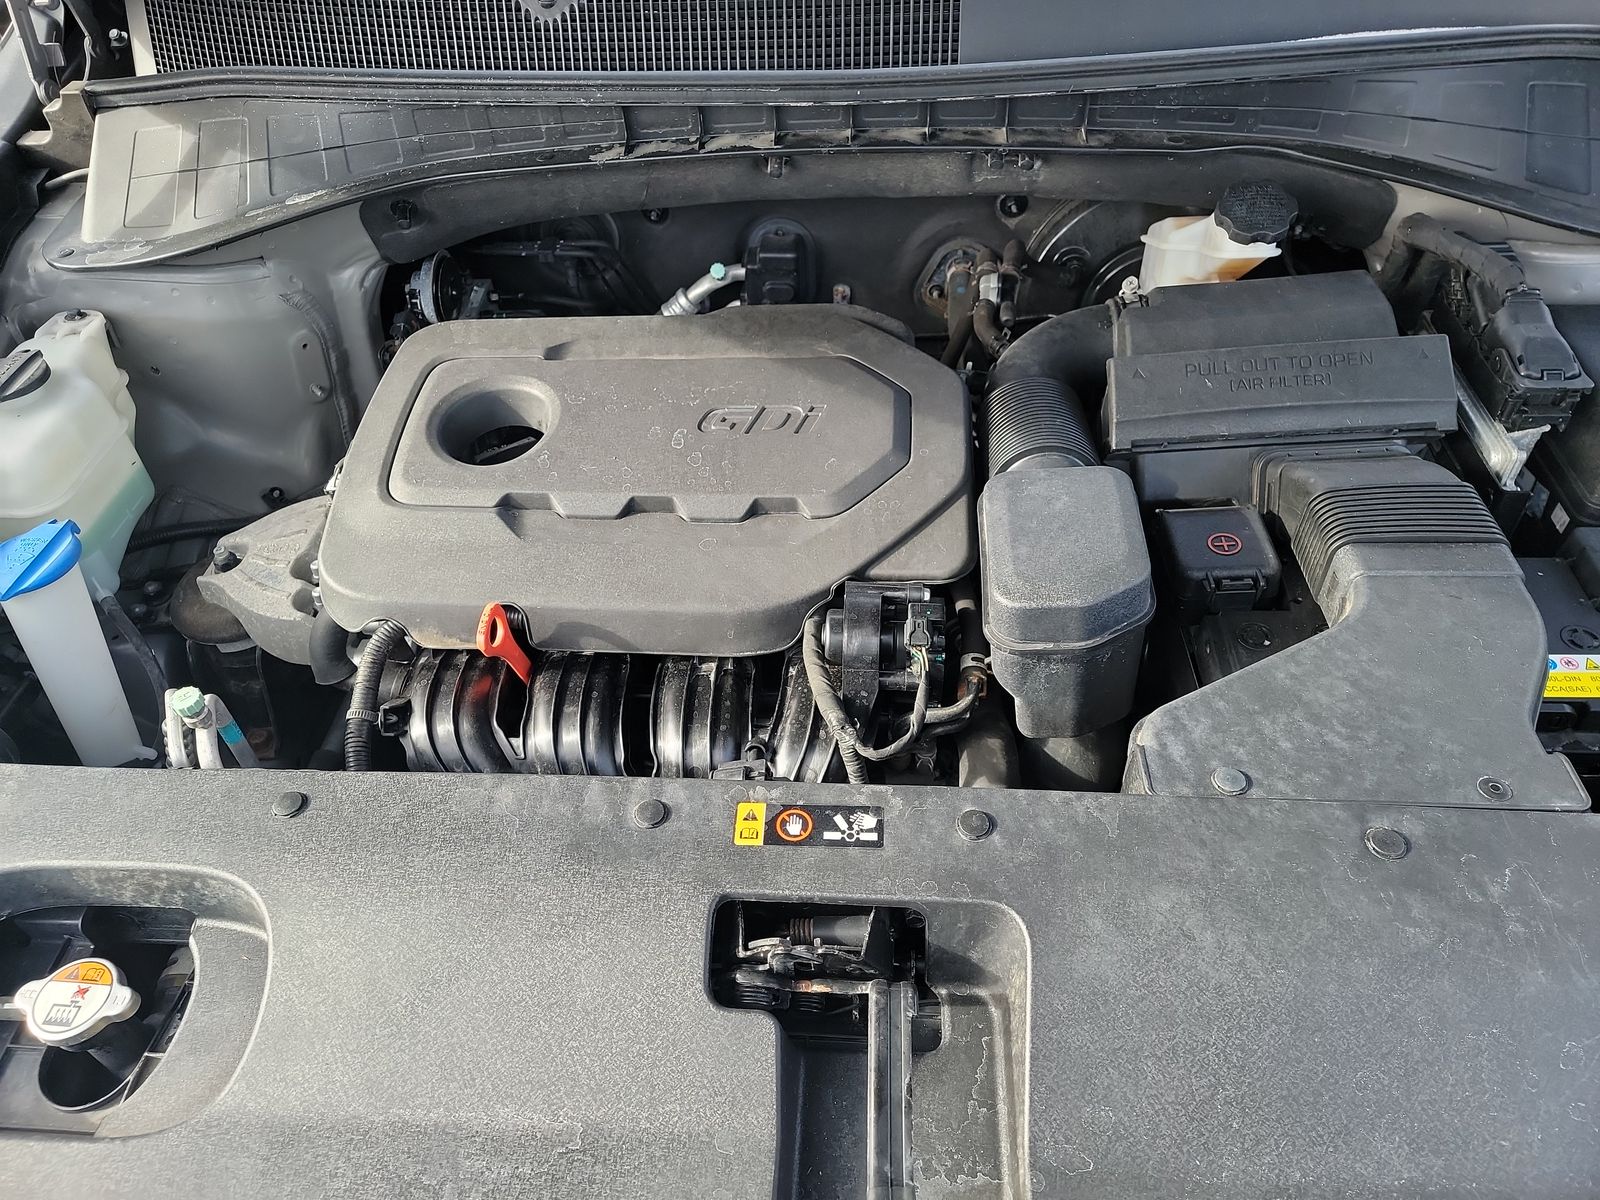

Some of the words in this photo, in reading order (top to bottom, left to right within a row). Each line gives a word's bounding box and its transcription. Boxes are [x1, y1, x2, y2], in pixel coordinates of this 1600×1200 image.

[1185, 360, 1236, 378] PULL
[1241, 356, 1281, 373] OUT
[1286, 355, 1313, 370] TO
[1319, 351, 1375, 368] OPEN
[696, 402, 827, 435] GDi
